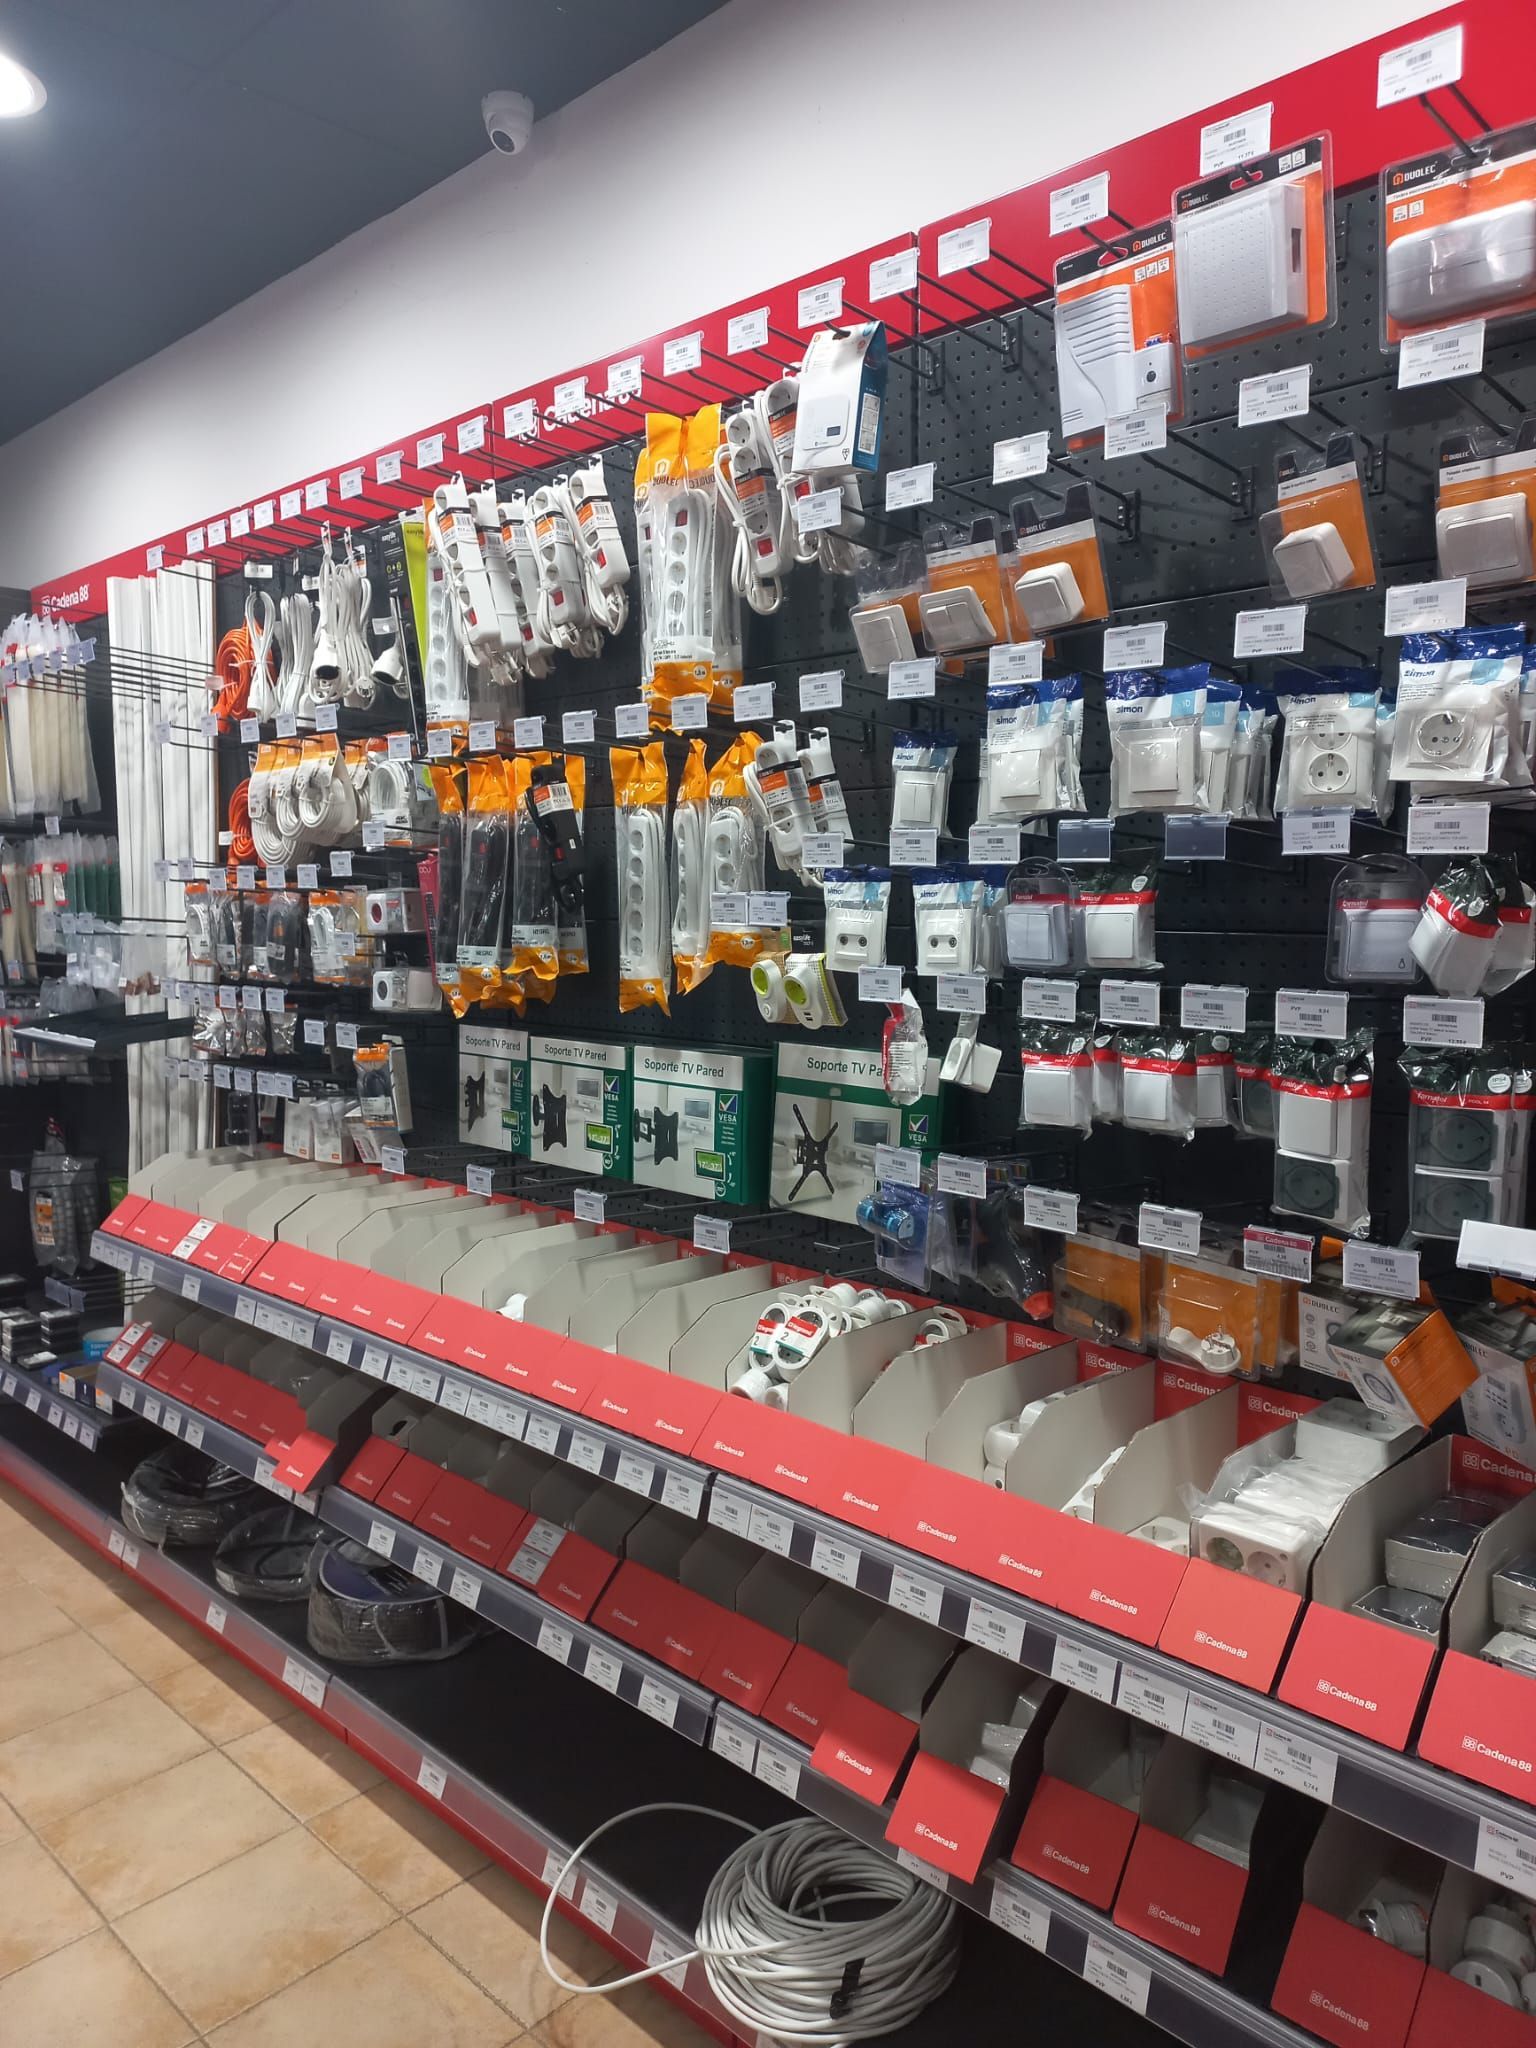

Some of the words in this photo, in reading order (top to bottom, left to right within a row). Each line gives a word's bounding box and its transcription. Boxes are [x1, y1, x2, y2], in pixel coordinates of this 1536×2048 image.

[1404, 163, 1436, 183] DUOLEC
[1141, 232, 1166, 248] DUOLEC
[51, 592, 79, 611] Cadena
[79, 584, 89, 602] 88
[465, 1035, 491, 1048] Soporte
[491, 1038, 501, 1049] TV
[501, 1040, 521, 1051] Pared
[544, 1044, 572, 1057] Soporte
[573, 1048, 584, 1058] TV
[585, 1048, 607, 1062] Pared
[644, 1058, 679, 1073] Soporte
[682, 1062, 694, 1074] TV
[696, 1064, 724, 1078] Pared
[807, 1057, 848, 1073] Soporte
[851, 1062, 866, 1075] TV
[719, 1114, 737, 1122] VESA
[908, 1134, 927, 1143] VESA
[1265, 1235, 1290, 1246] Cadena
[1311, 1300, 1339, 1314] DUOLEC
[781, 1332, 789, 1341] 2
[792, 1322, 812, 1336] legrand
[754, 1336, 760, 1346] 2
[721, 1443, 737, 1455] Cadena
[782, 1468, 801, 1480] Cadena
[1481, 1459, 1533, 1483] Cadena
[851, 1495, 872, 1509] Cadena
[925, 1525, 949, 1540] Cadena
[948, 1534, 957, 1542] 88
[1008, 1558, 1033, 1574] Cadena
[1032, 1569, 1043, 1578] 88
[1100, 1595, 1128, 1611] Cadena
[1127, 1605, 1138, 1615] 88
[1206, 1636, 1237, 1655] Cadena
[1236, 1648, 1248, 1659] 88
[1329, 1686, 1365, 1707] Cadena
[1365, 1700, 1377, 1712] 88
[844, 1755, 865, 1773] Cadena
[863, 1765, 873, 1776] 88
[1477, 1743, 1518, 1767] Cadena
[1518, 1760, 1532, 1773] 88
[1273, 1767, 1285, 1776] PVP
[924, 1828, 950, 1848] Cadena
[948, 1840, 958, 1851] 88
[1052, 1850, 1080, 1870] Cadena
[1079, 1864, 1090, 1875] 88
[1500, 1871, 1514, 1880] PVP
[1159, 1911, 1191, 1931] Cadena
[1190, 1923, 1201, 1937] 88
[1322, 1999, 1357, 2026] Cadena
[1357, 2018, 1369, 2031] 88
